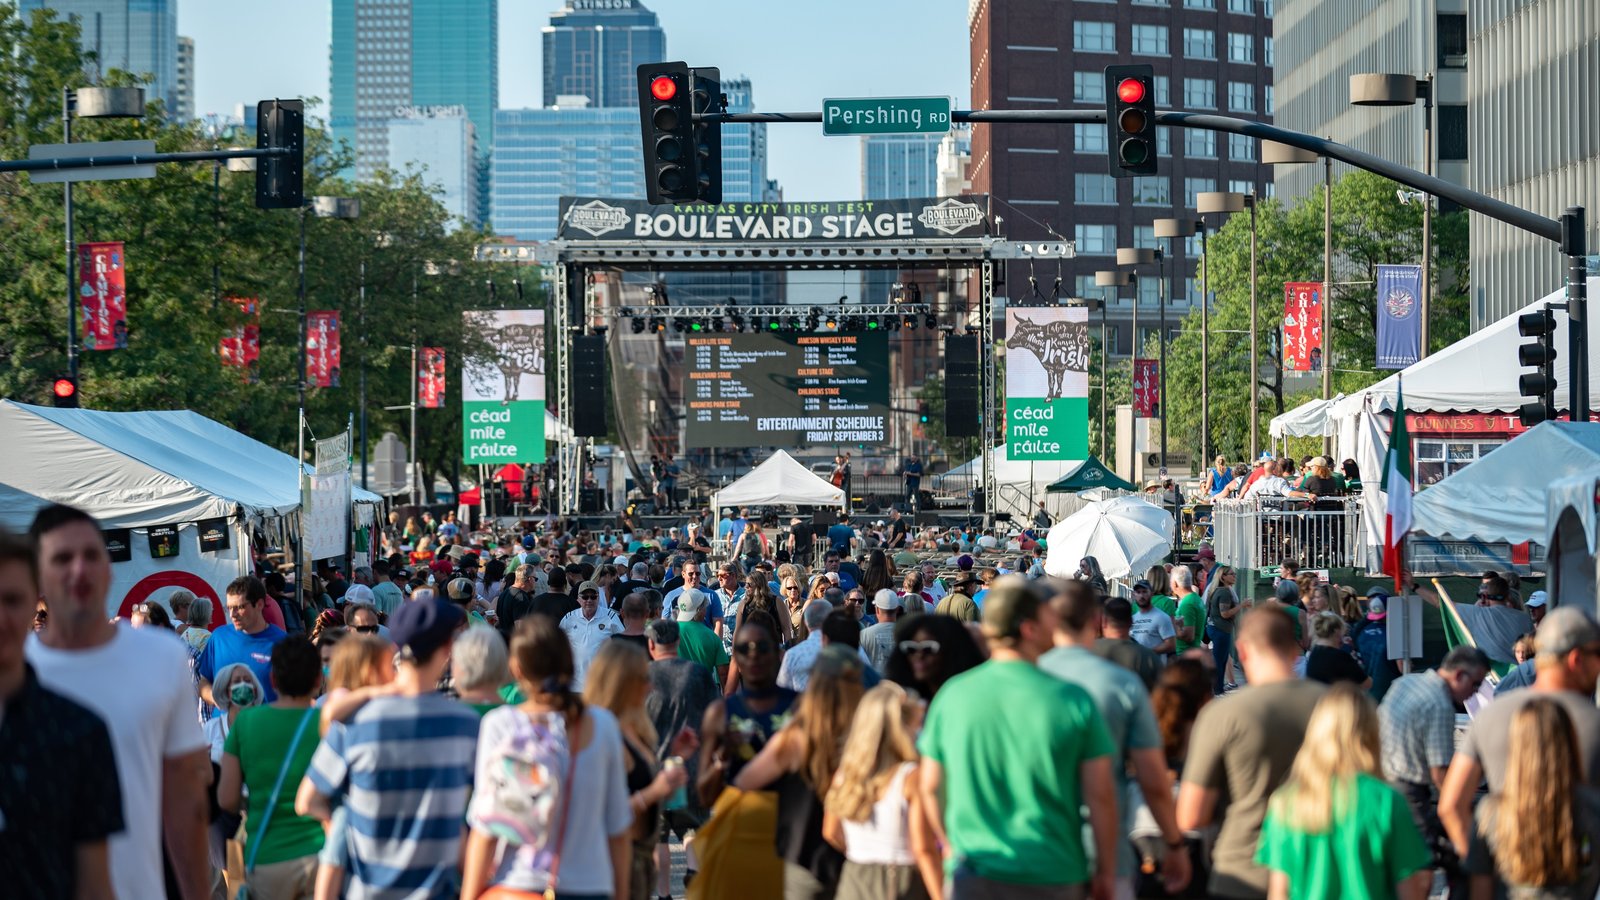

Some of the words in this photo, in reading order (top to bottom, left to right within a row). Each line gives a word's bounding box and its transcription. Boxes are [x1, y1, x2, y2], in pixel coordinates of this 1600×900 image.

[574, 0, 632, 9] STINSON
[394, 105, 422, 118] ONE
[424, 104, 464, 117] LIGHT
[829, 105, 921, 129] Pershing
[929, 112, 947, 123] RD
[674, 203, 736, 214] KANSAS
[744, 203, 779, 214] CITY
[787, 203, 829, 214] IRISH
[837, 202, 874, 213] FEST
[927, 207, 976, 224] BOULEVARD
[573, 209, 622, 225] BOULEVARD
[634, 213, 813, 239] BOULEVARD
[822, 212, 914, 239] STAGE
[1298, 292, 1308, 358] CHAMPIONS
[1051, 337, 1076, 348] Kansas
[1042, 340, 1088, 371] Irish
[470, 408, 511, 423] céad
[1013, 405, 1054, 420] céad
[757, 417, 834, 431] ENTERTAINMENT
[835, 416, 884, 430] SCHEDULE
[1414, 416, 1474, 430] GUINNESS
[806, 431, 833, 442] FRIDAY
[834, 430, 878, 442] SEPTEMBER
[878, 430, 884, 441] 3
[1434, 544, 1485, 555] JAMESON
